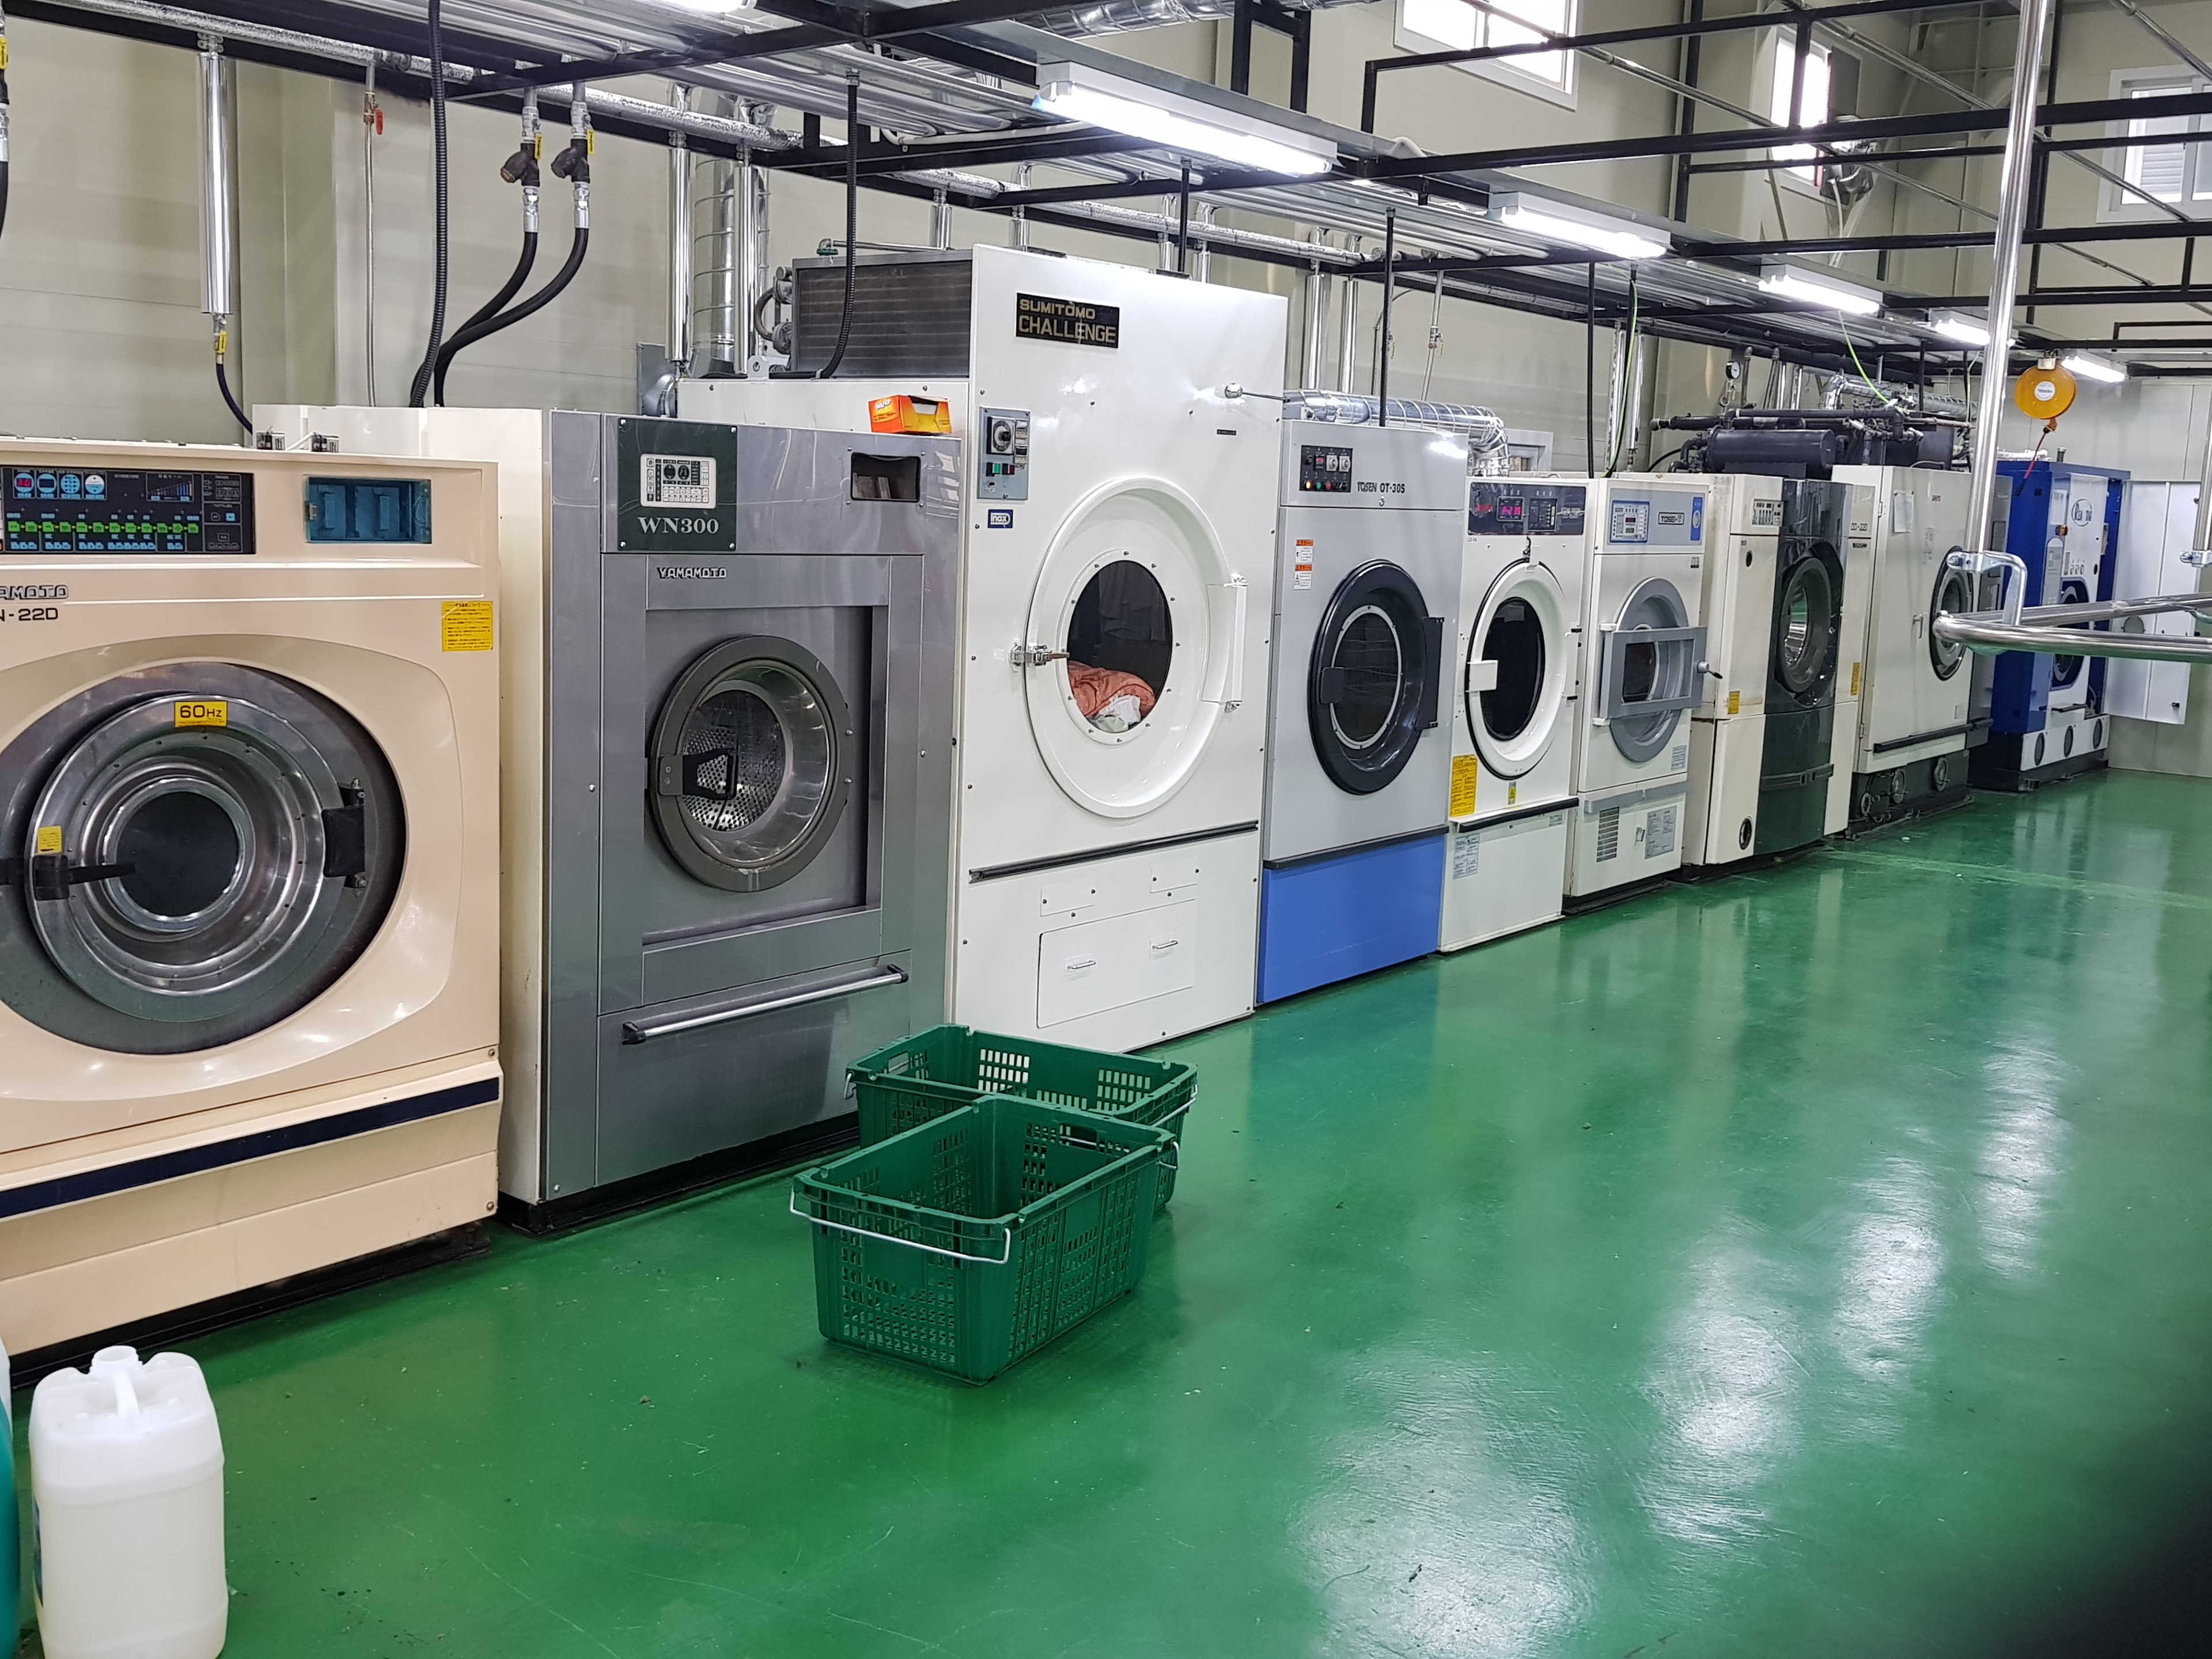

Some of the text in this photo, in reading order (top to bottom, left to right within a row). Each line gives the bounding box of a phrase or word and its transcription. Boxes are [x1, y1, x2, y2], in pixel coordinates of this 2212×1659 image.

[1019, 298, 1096, 320] SUMITOMO
[1018, 315, 1116, 343] CHALLENGE
[637, 517, 719, 534] WN300
[657, 567, 728, 579] YAMAMOTO
[180, 704, 222, 719] 60Hz
